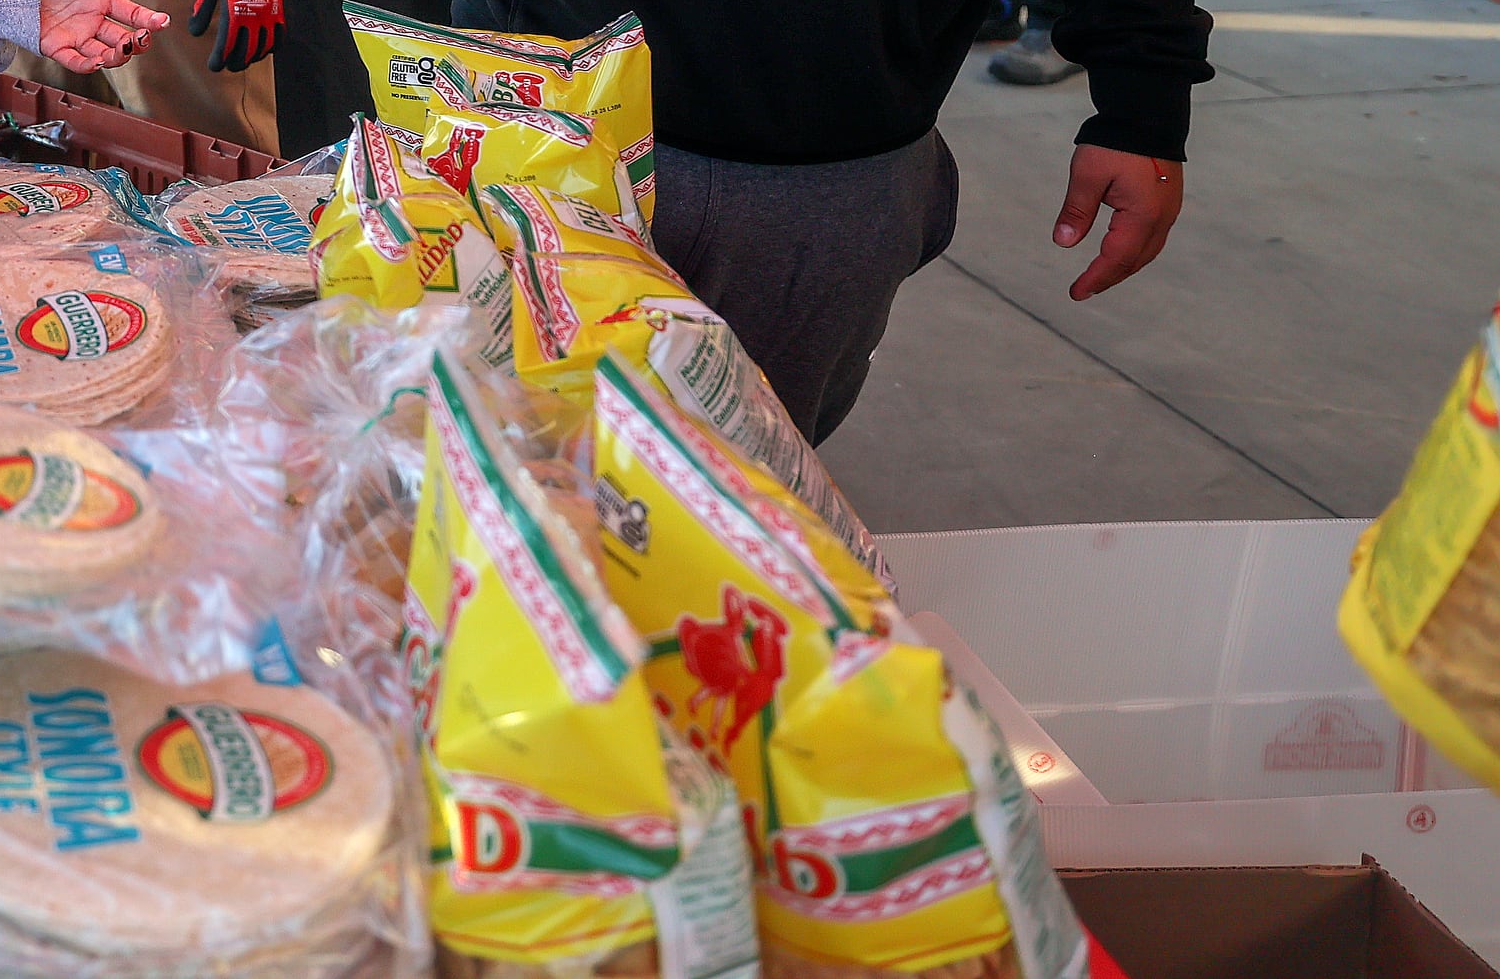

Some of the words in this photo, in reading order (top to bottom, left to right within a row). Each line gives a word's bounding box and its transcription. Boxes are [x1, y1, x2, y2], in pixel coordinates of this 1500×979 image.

[390, 73, 407, 83] FREE
[391, 62, 419, 74] GLUTEN
[418, 222, 464, 286] LIDAD
[56, 294, 101, 358] GUERRERO
[28, 688, 140, 851] SONORA
[195, 704, 264, 819] GUERRERO
